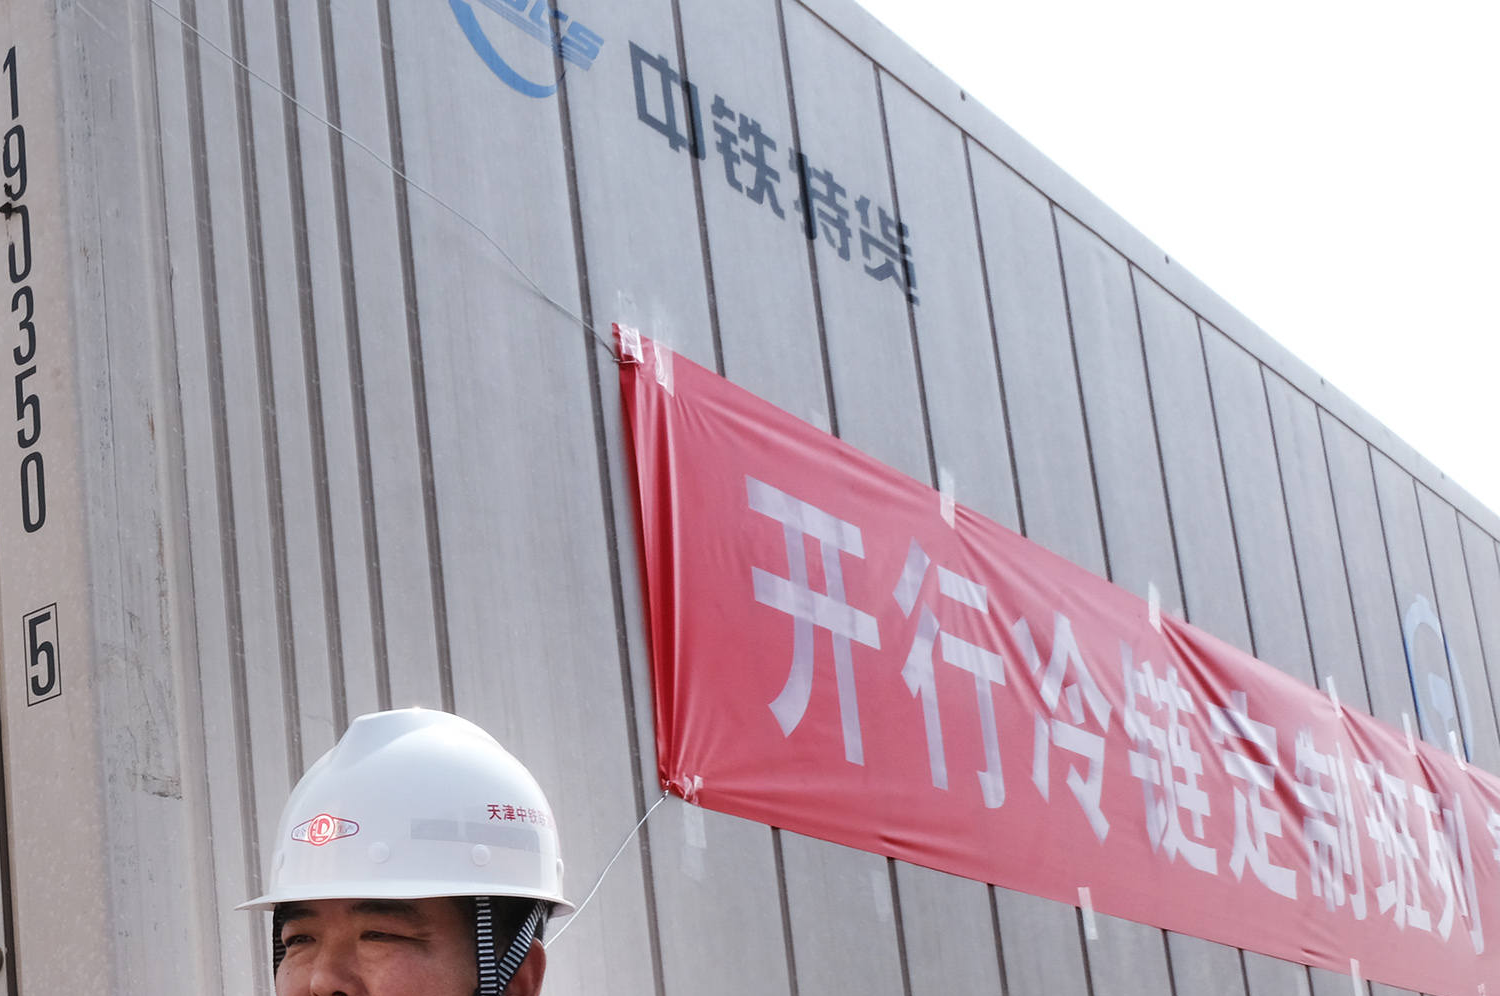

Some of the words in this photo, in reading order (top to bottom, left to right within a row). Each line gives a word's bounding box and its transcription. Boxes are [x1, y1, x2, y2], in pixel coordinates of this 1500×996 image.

[629, 40, 920, 306] 中铁特货
[744, 474, 1500, 956] 开行冷链定制班列
